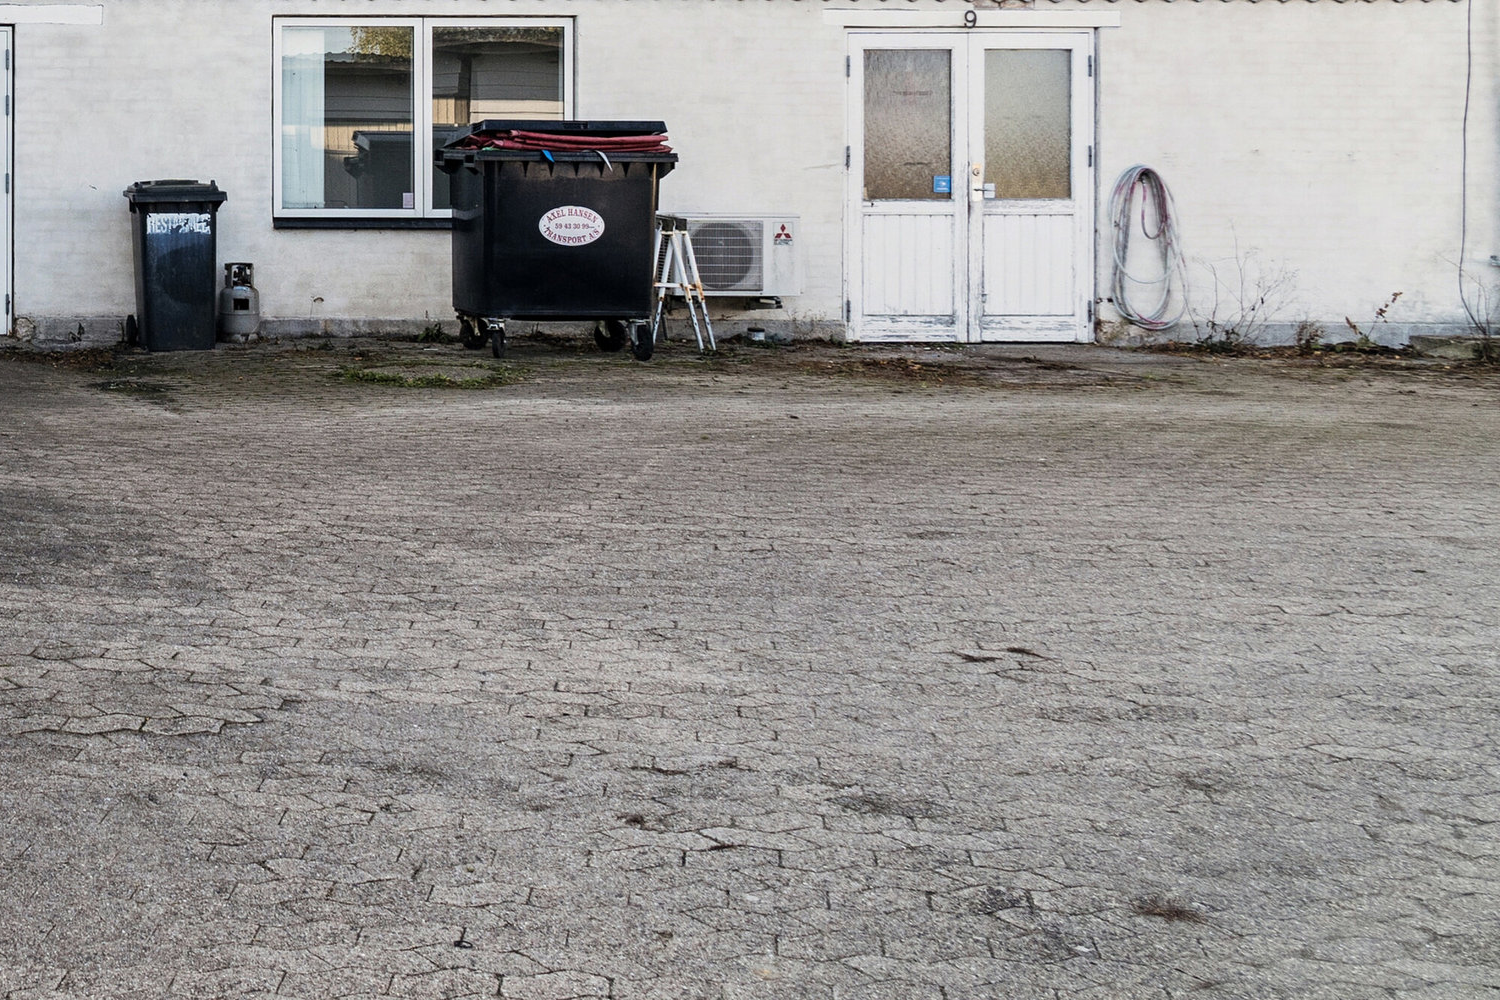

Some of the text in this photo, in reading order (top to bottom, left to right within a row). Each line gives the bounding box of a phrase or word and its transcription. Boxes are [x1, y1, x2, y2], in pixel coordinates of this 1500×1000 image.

[963, 10, 978, 29] 9
[546, 208, 599, 223] AXEL HANSEN
[544, 226, 587, 244] TRANSPORT
